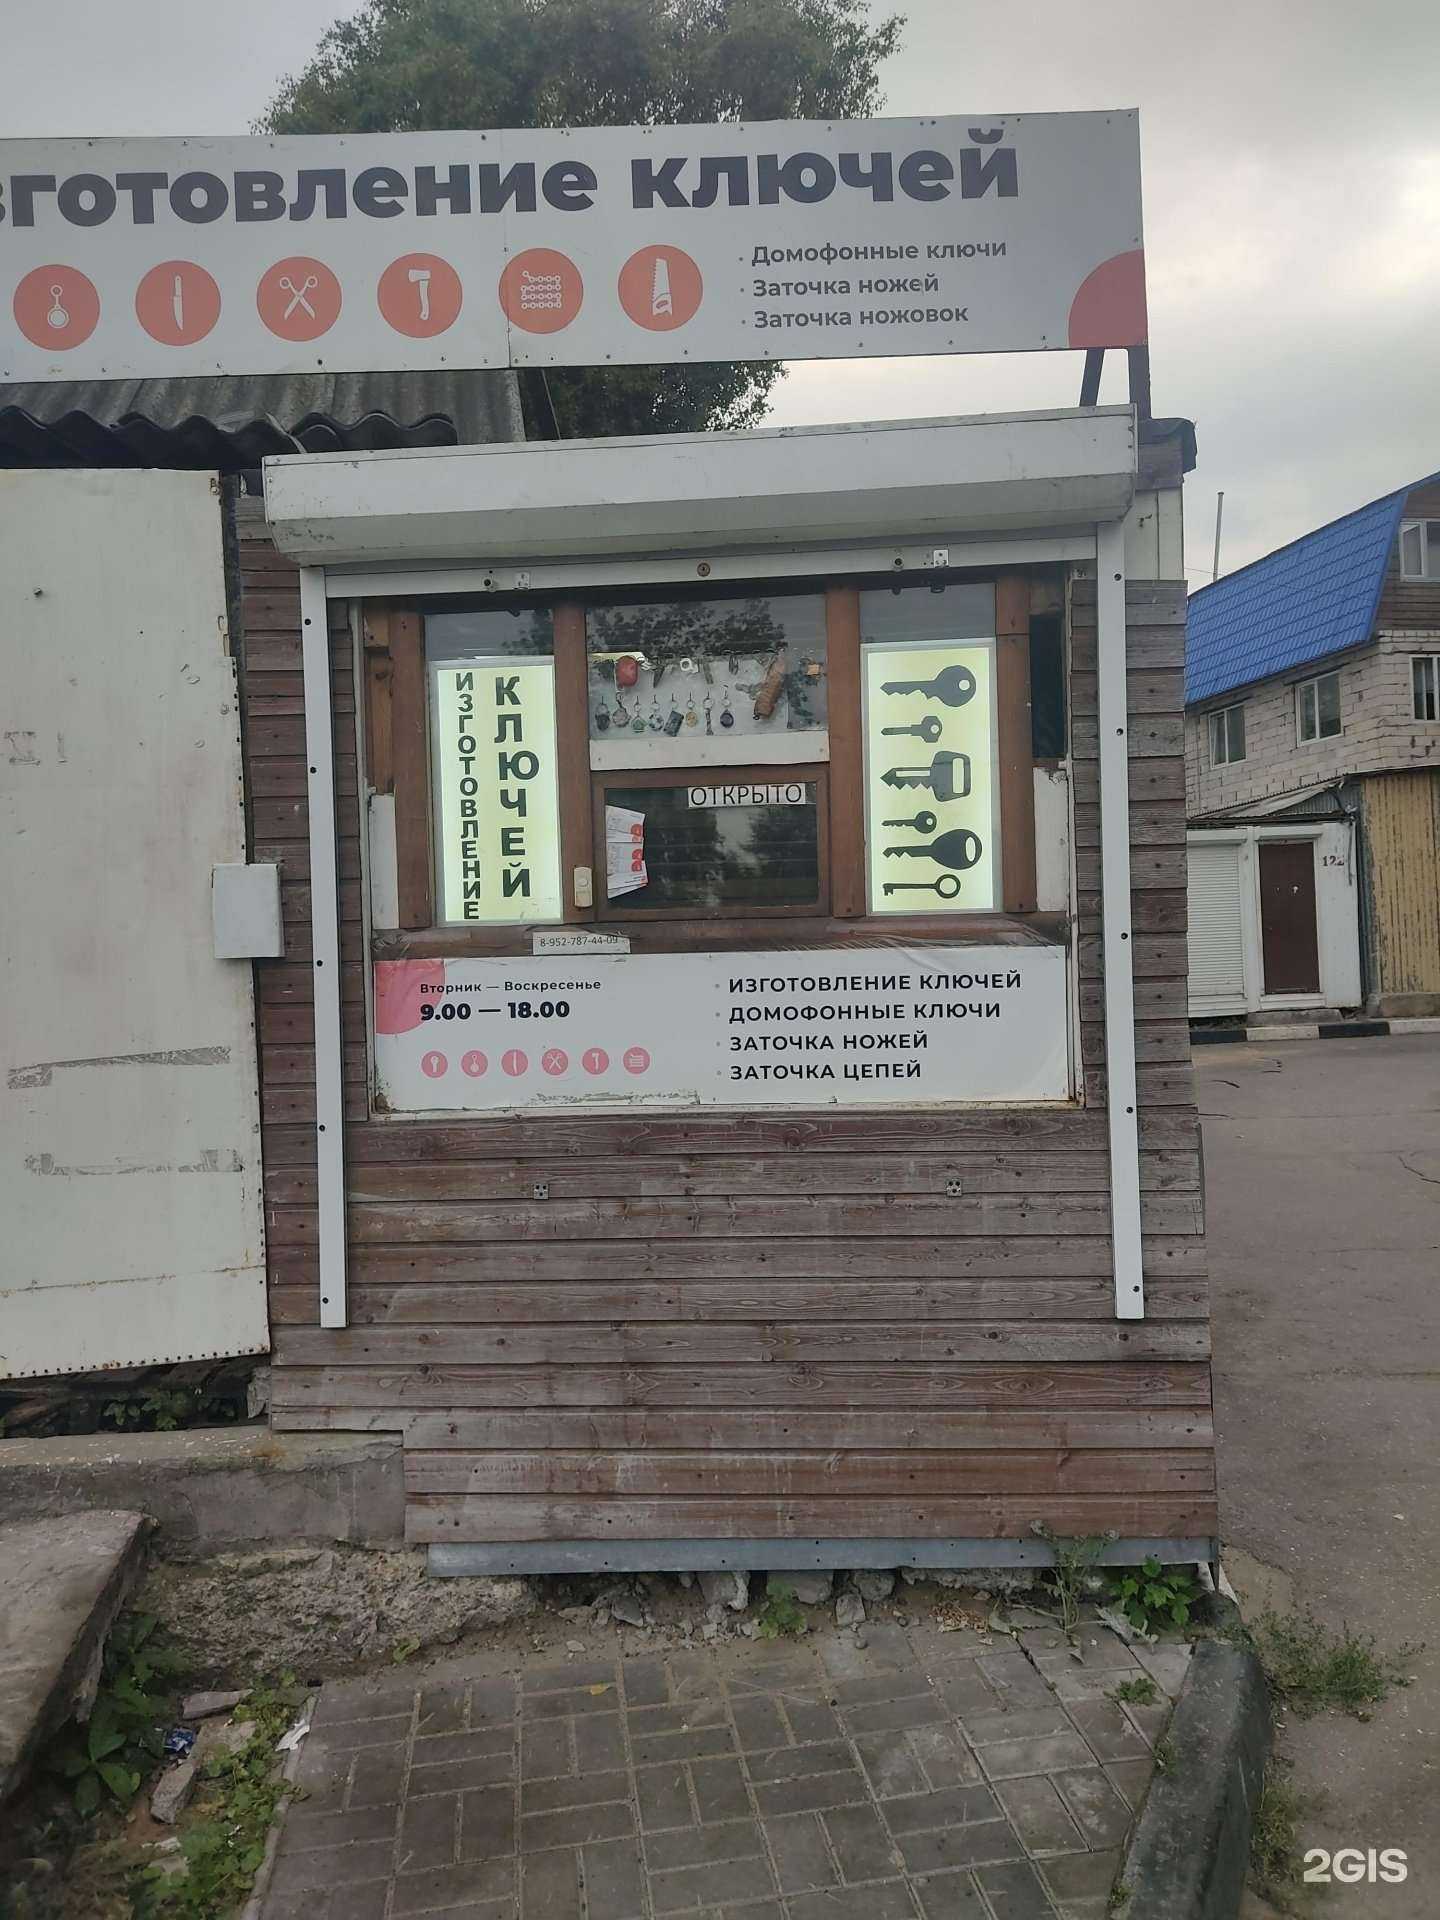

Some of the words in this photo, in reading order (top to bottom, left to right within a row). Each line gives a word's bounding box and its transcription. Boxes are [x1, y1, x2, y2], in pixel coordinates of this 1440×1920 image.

[0, 160, 598, 227] готовление
[631, 128, 1019, 208] ключей
[751, 243, 919, 267] Домофонные
[926, 239, 1007, 259] ключи
[752, 277, 852, 298] Заточка
[859, 273, 939, 295] ножей
[753, 308, 853, 329] Заточка
[859, 305, 969, 326] ножовок
[455, 672, 481, 919] ИЗГОТОВЛЕНИЕ
[494, 675, 539, 898] КЛЮЧЕЙ
[690, 784, 802, 806] ОТКРЫТО
[539, 935, 618, 947] 8-952-787-44-09
[420, 982, 482, 995] Вторник
[504, 979, 602, 993] Воскресенье
[729, 975, 912, 993] ИЗГОТОВЛЕНИЕ
[920, 969, 1022, 990] КЛЮЧЕЙ
[420, 1003, 471, 1021] 9.00
[507, 1001, 570, 1019] 18.00
[729, 1004, 906, 1024] ДОМОФОННЫЕ
[914, 1003, 1001, 1019] КЛЮЧИ
[730, 1035, 834, 1051] ЗАТОЧКА
[843, 1030, 929, 1049] НОЖЕЙ
[730, 1064, 835, 1080] ЗАТОЧКА
[843, 1060, 922, 1081] ЦЕПЕЙ
